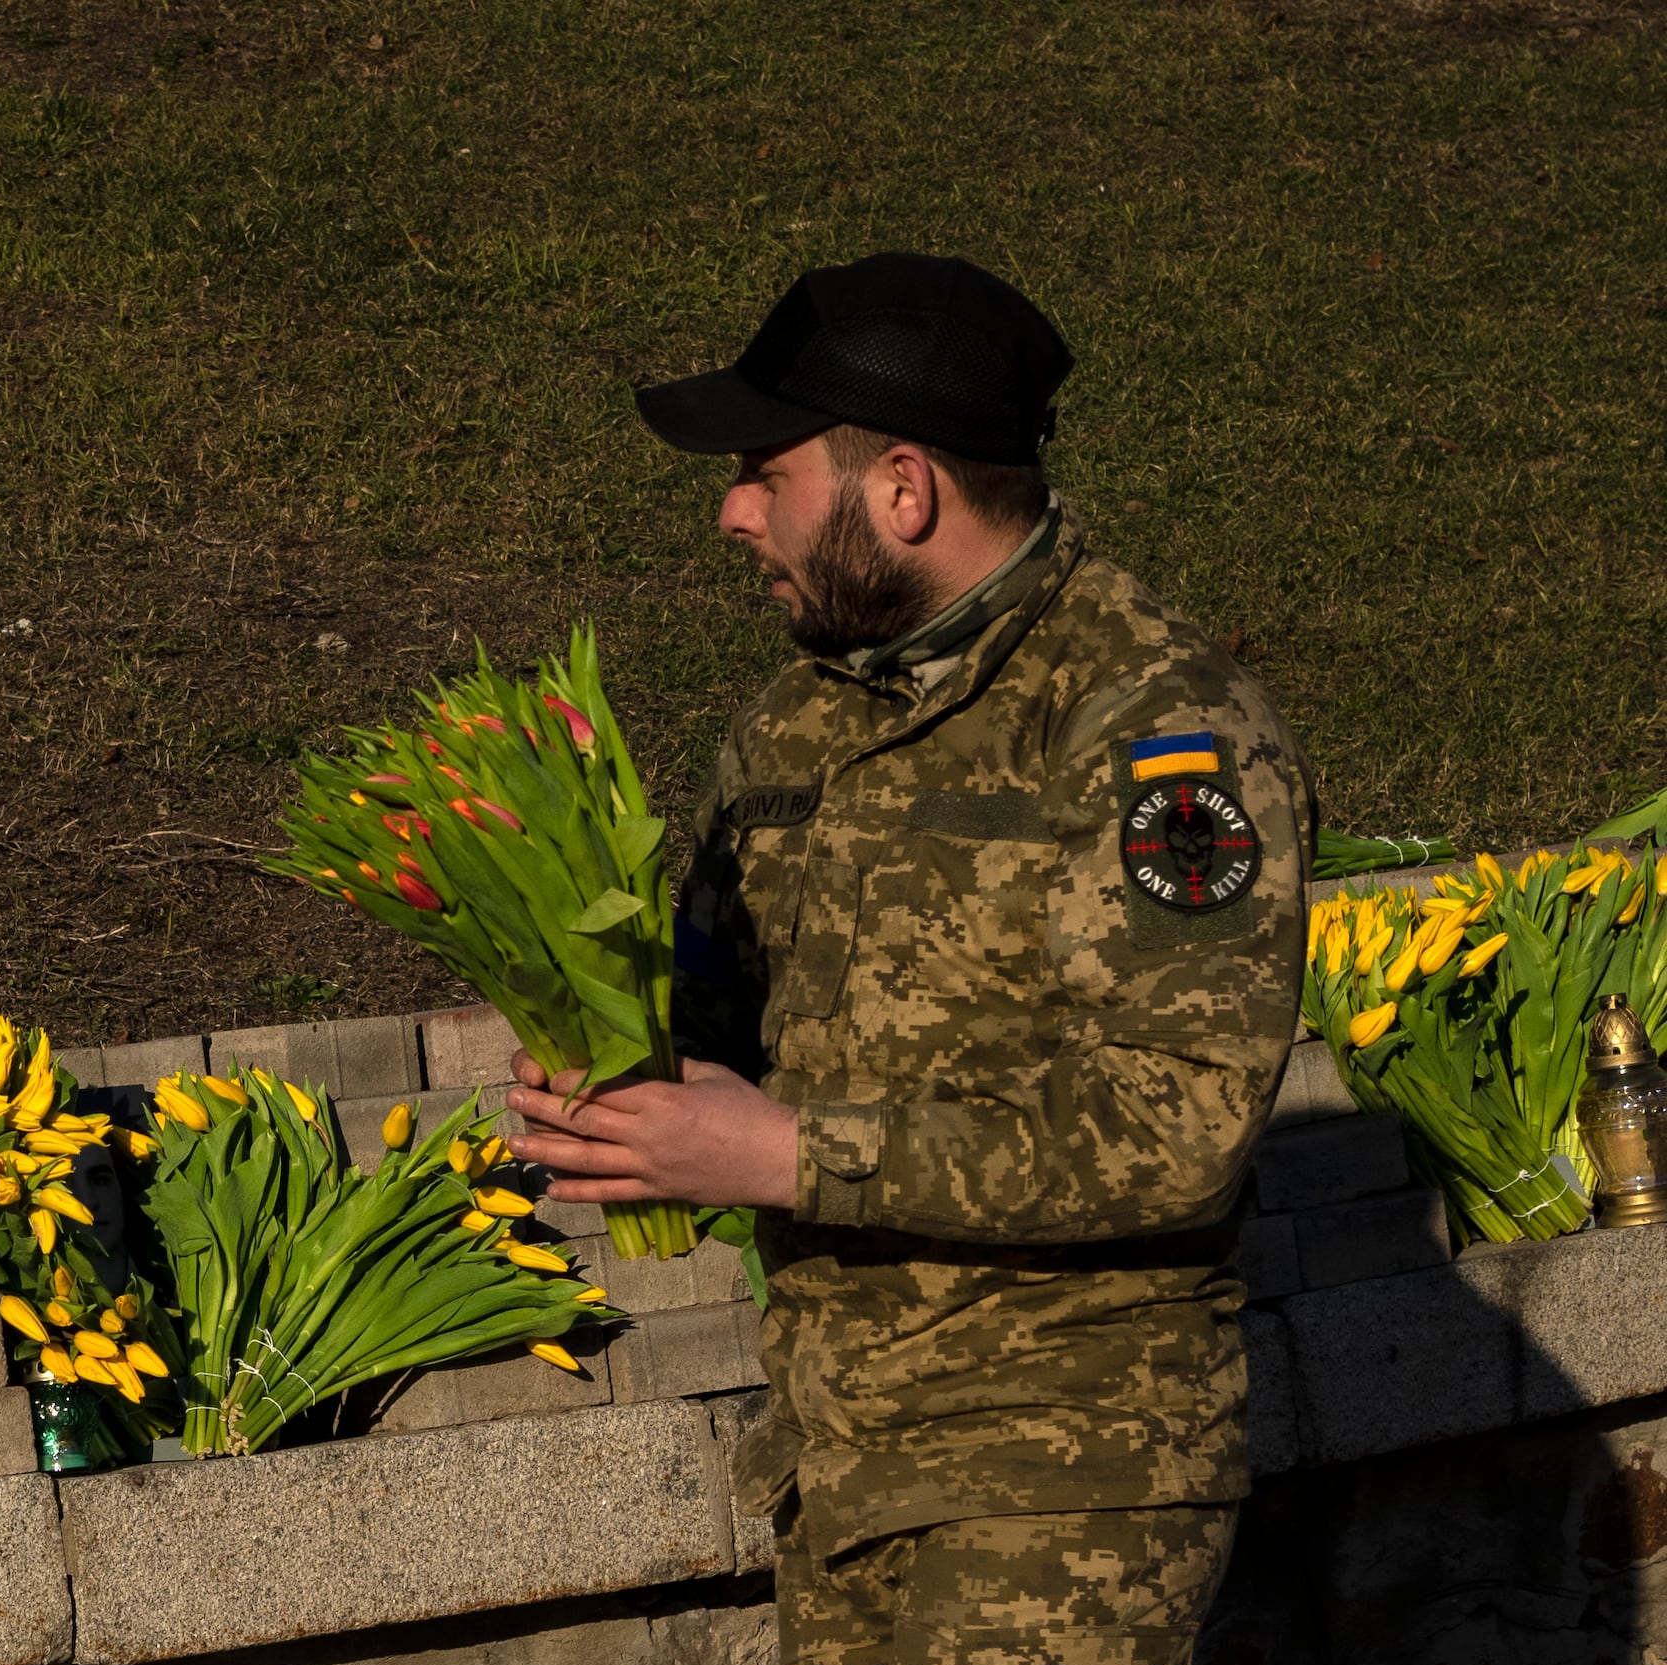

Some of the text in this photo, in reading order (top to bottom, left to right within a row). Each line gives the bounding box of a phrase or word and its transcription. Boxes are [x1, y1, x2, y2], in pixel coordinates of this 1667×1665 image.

[1131, 786, 1251, 831] ONE SHOT
[1137, 860, 1251, 900] ONE KILL
